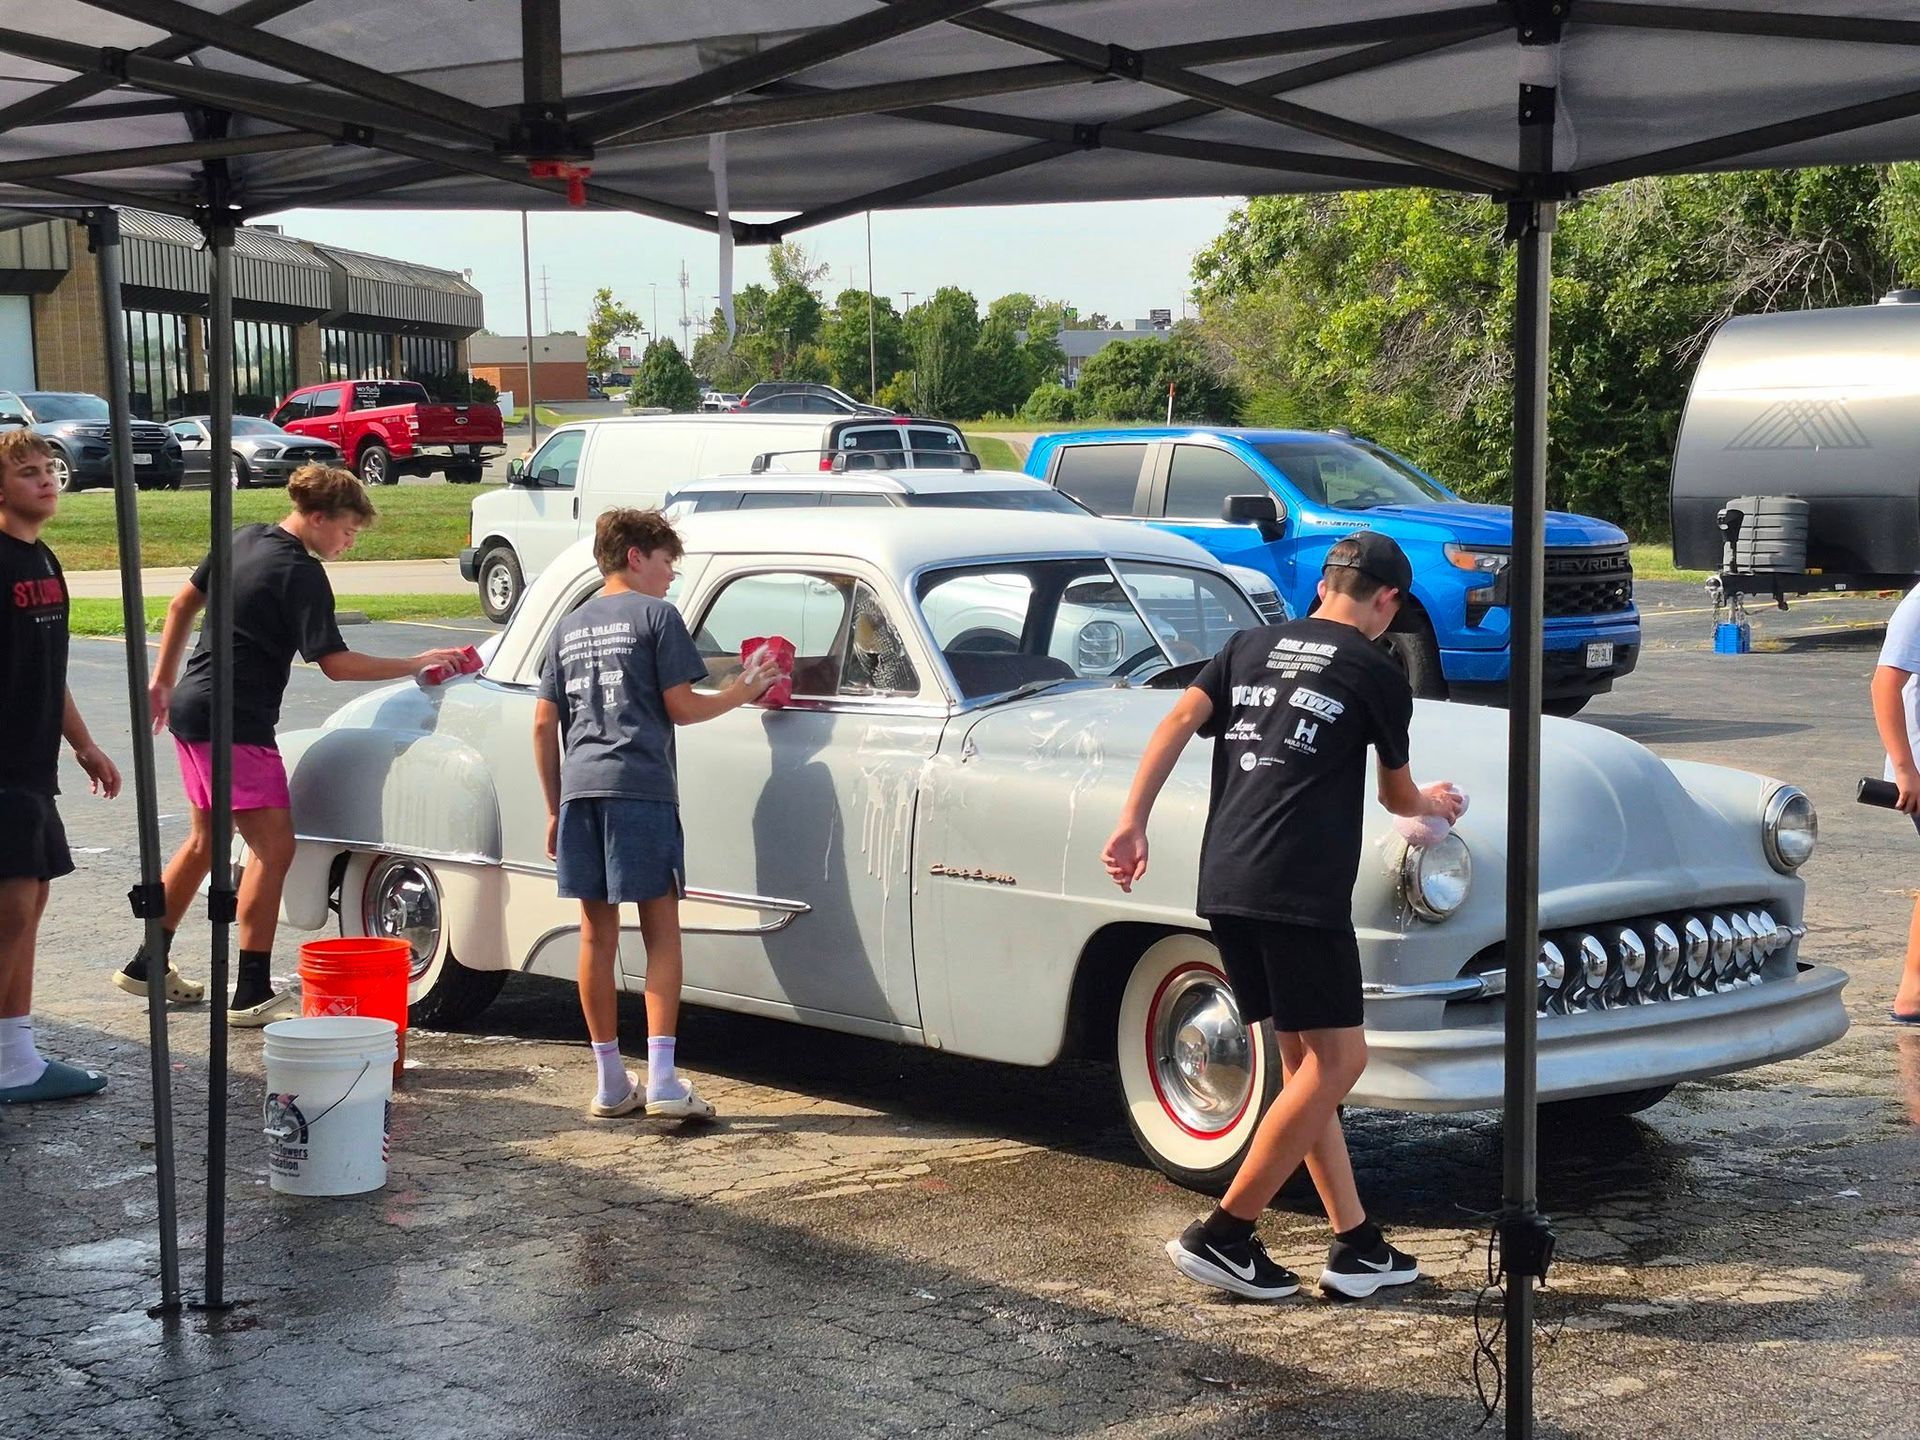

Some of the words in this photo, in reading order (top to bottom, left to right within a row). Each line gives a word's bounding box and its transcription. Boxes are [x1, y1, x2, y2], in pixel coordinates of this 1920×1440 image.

[1315, 520, 1371, 528] SILVERADO
[1545, 556, 1628, 572] HEVROLE
[564, 627, 589, 644] CORE
[591, 622, 631, 637] VALUES
[1274, 638, 1304, 651] CORE
[1301, 642, 1338, 657] VALUES
[1281, 670, 1297, 679] LOVE
[278, 1144, 308, 1158] Towers
